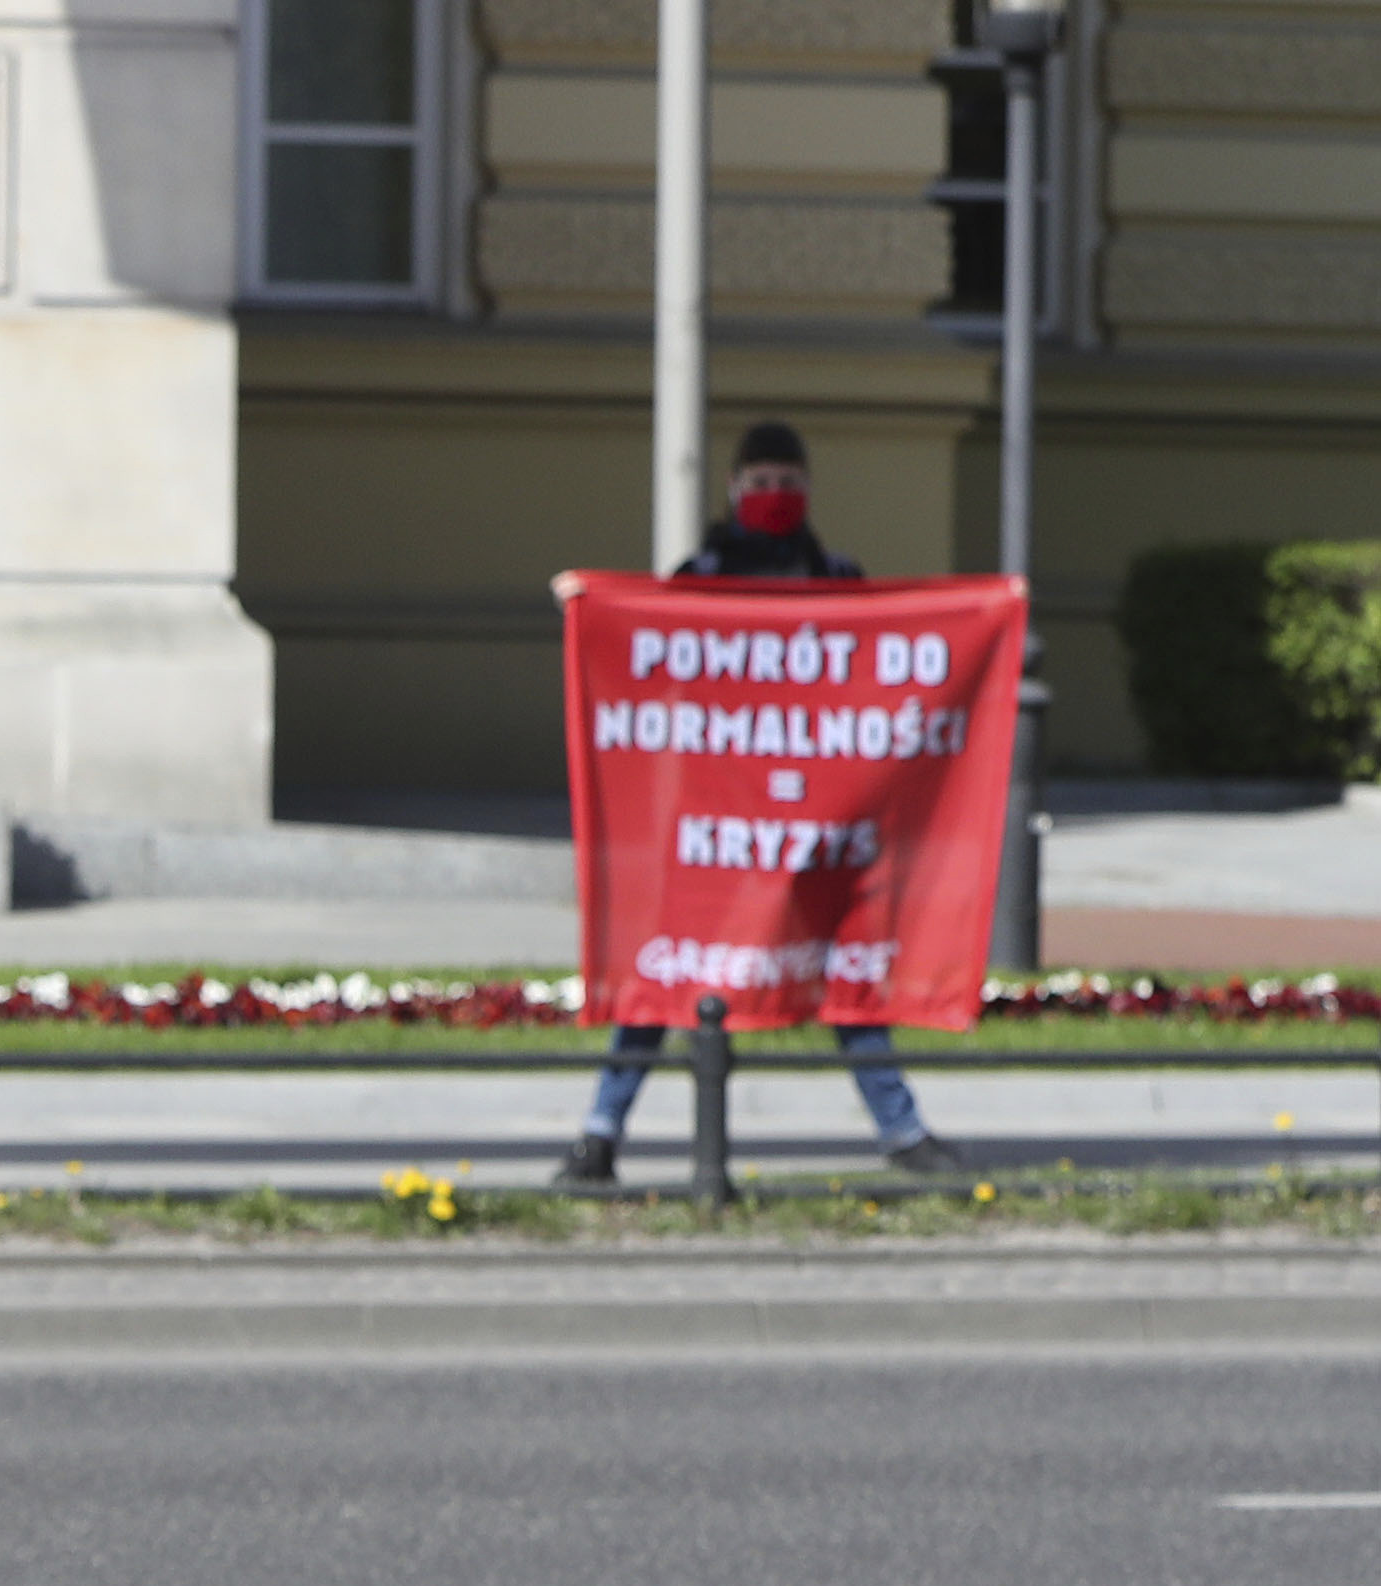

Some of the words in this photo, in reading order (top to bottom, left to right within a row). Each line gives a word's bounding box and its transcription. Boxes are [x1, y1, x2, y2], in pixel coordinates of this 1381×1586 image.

[631, 622, 856, 683] POWRÓT
[875, 632, 950, 686] DO
[594, 697, 967, 760] NORMALNOŚCI
[678, 815, 879, 872] KRYZYS
